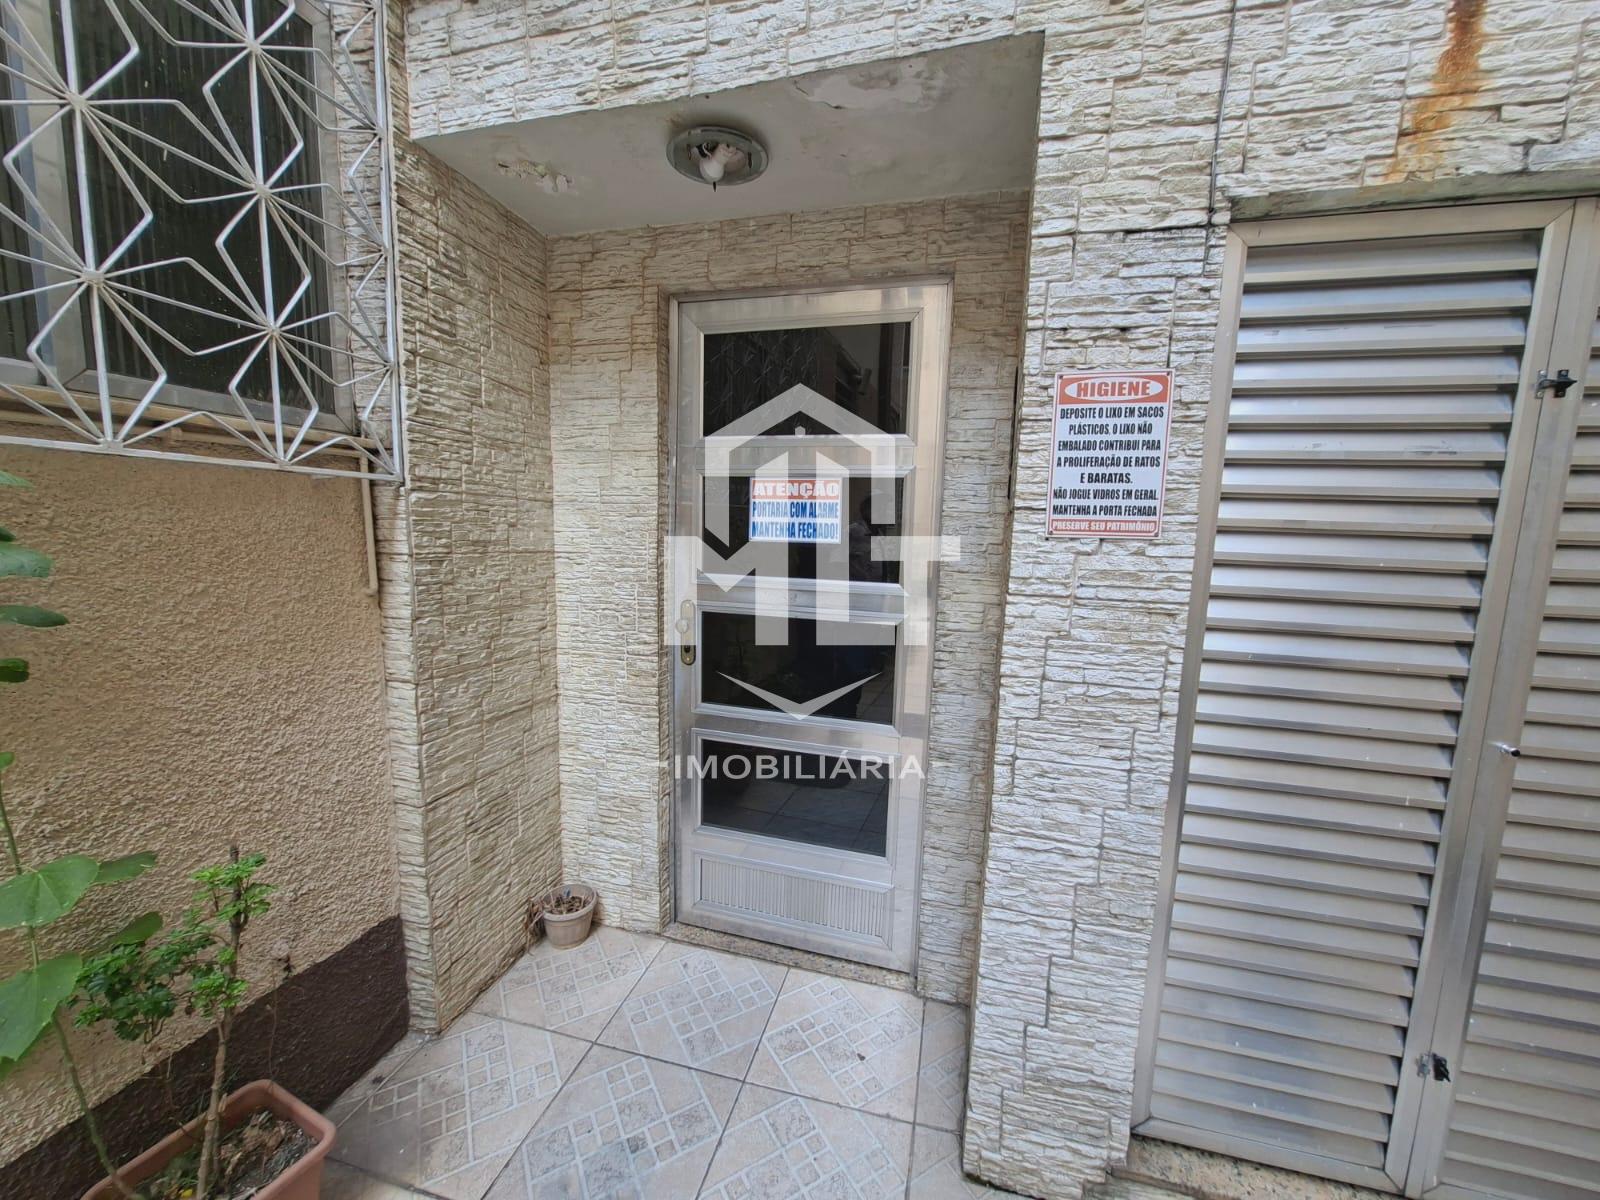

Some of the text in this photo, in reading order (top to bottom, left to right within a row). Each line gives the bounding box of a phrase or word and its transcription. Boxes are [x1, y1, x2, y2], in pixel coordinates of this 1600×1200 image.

[1076, 381, 1151, 397] HIGIENE
[1060, 406, 1164, 419] DEPOSITE O LIXO EM SACOS
[1113, 424, 1117, 435] O
[1119, 423, 1135, 434] LIXO
[1137, 421, 1152, 434] NÃO
[1058, 440, 1161, 451] EMBALADO CONTRIBUI PARA
[1057, 455, 1160, 469] A PROLIFERAÇÃO DE RATOS
[1080, 473, 1133, 483] E BARATAS.
[753, 480, 838, 498] ATENÇÃO
[1053, 486, 1067, 499] NÃO
[1069, 489, 1091, 499] JOGUE
[1093, 489, 1120, 499] VIDROS
[1122, 489, 1132, 499] EM
[752, 502, 838, 518] PORTARIA COM ALARME
[1052, 505, 1157, 516] MANTENHA A PORTA FECHADA
[752, 521, 795, 538] MANTENHA
[1053, 522, 1090, 530] PRESERVE
[1091, 522, 1105, 530] SEU
